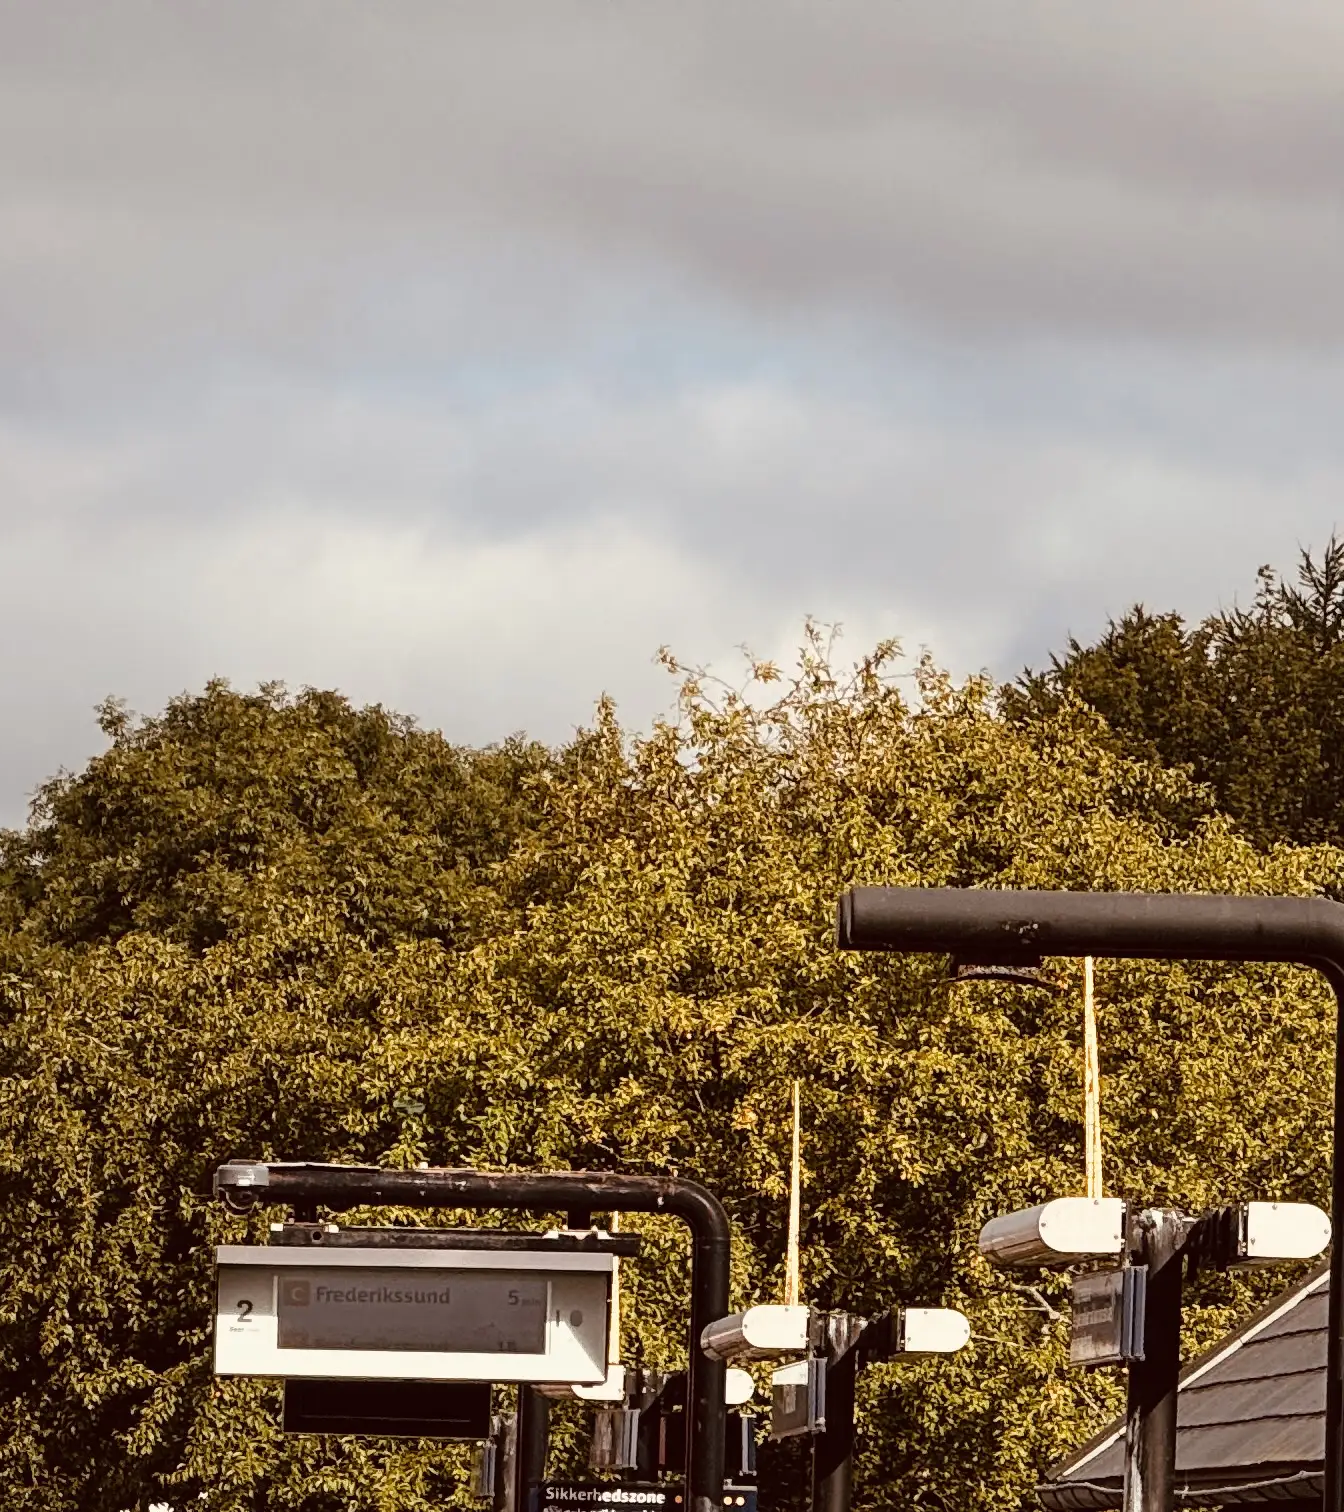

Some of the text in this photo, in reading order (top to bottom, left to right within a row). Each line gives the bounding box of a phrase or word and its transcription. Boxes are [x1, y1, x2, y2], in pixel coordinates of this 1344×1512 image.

[291, 1286, 304, 1300] C
[316, 1286, 450, 1304] Frederikssund
[508, 1289, 519, 1305] 5
[237, 1299, 253, 1322] 2
[545, 1486, 666, 1504] Sikkerhedszone
